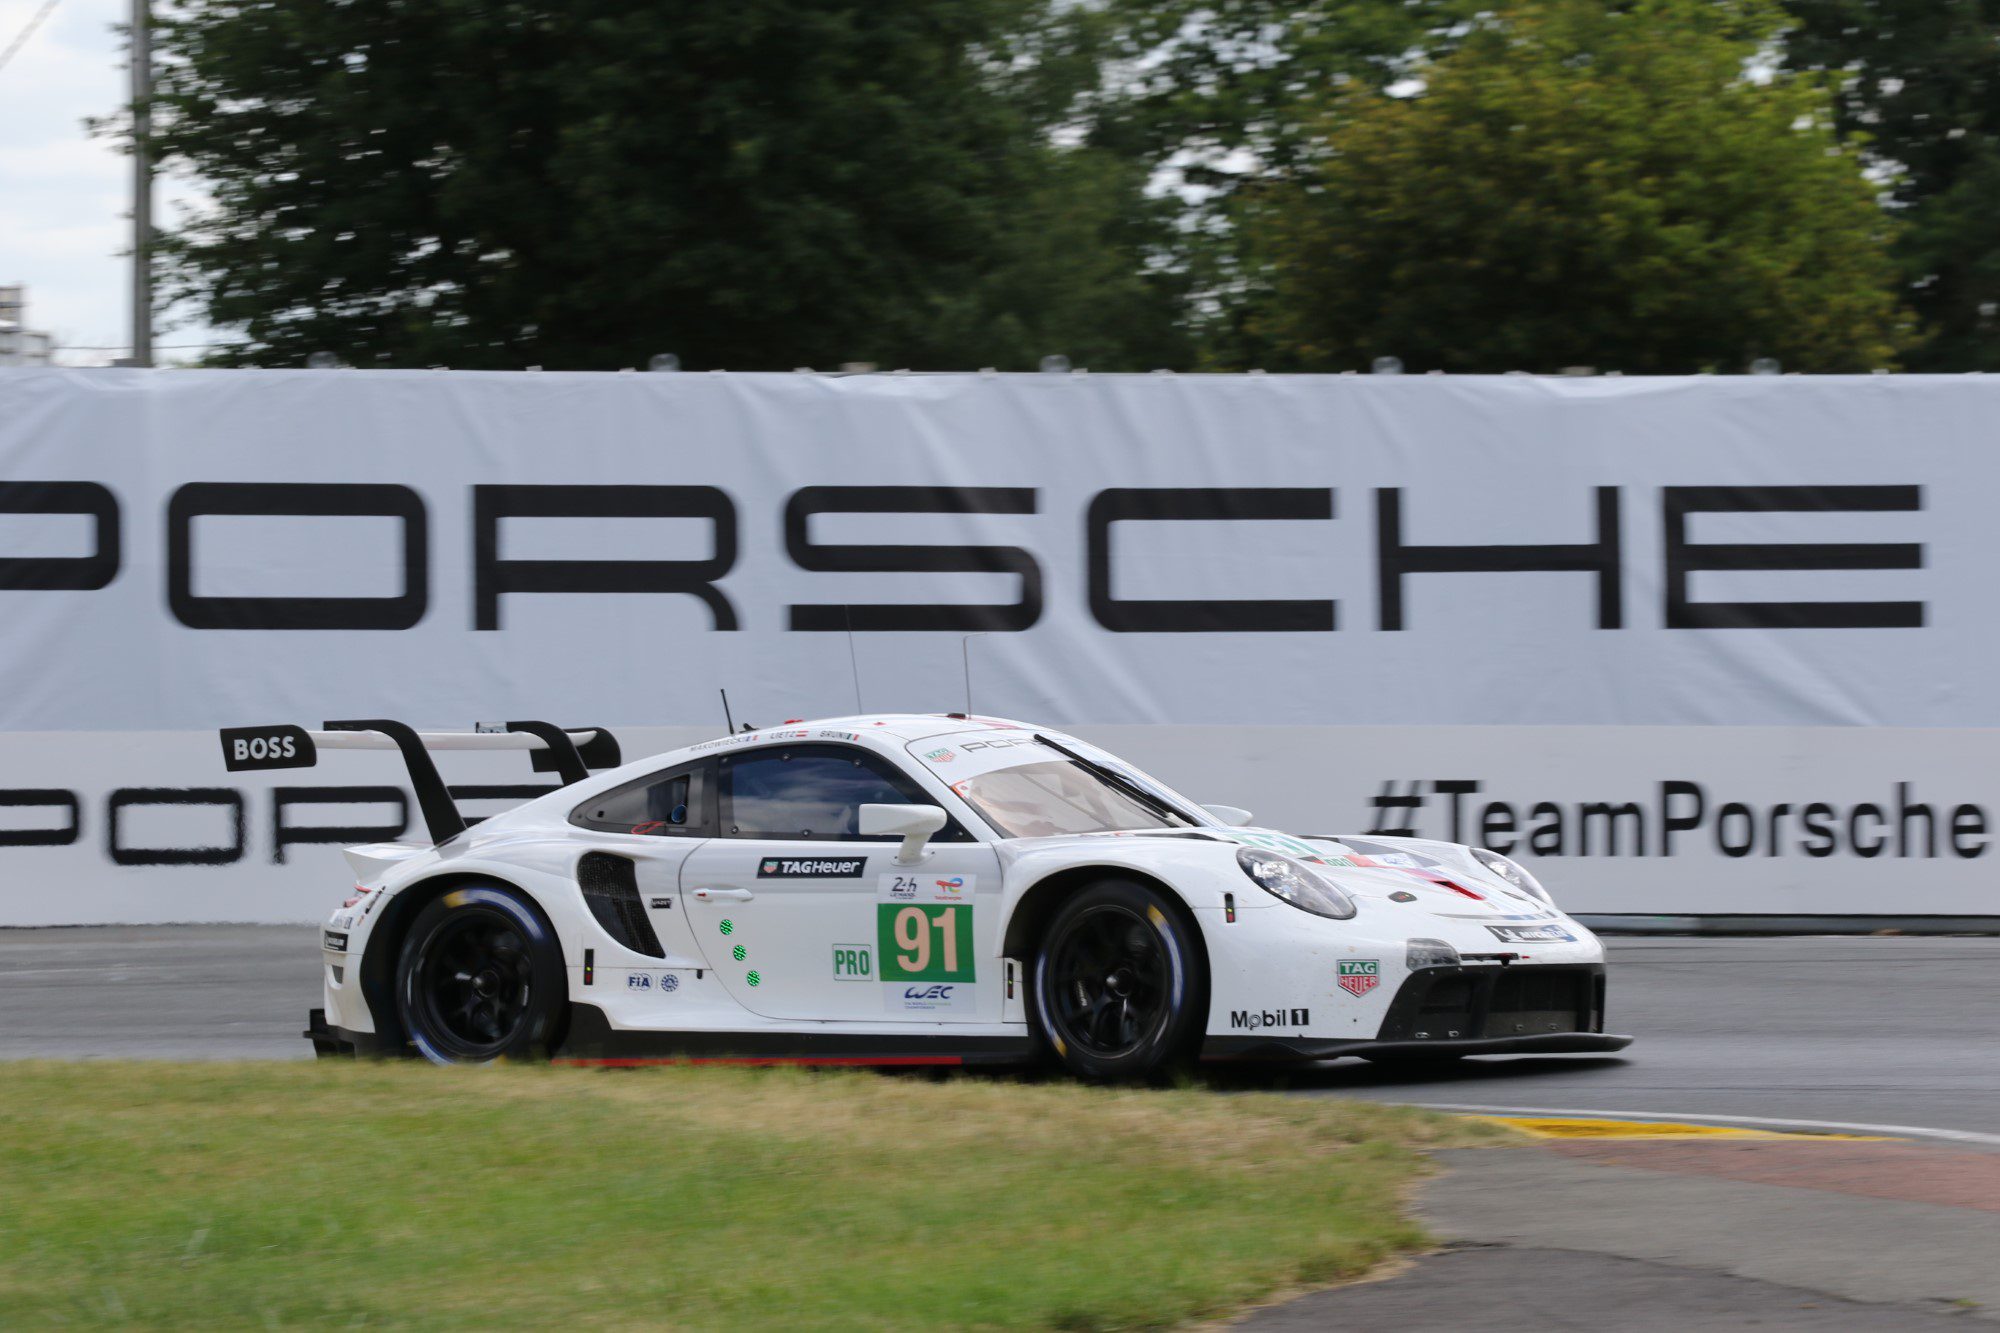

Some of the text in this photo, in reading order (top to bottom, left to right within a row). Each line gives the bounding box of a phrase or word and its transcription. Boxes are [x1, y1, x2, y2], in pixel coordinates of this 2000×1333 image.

[233, 736, 296, 761] BOSS
[1366, 780, 1992, 859] #TeamPorsche
[894, 906, 958, 972] 91
[835, 950, 870, 976] PRO
[1341, 963, 1376, 974] TAG
[904, 985, 954, 999] WEC
[1340, 975, 1377, 992] HEUER
[1231, 1009, 1307, 1030] Mobil 1
